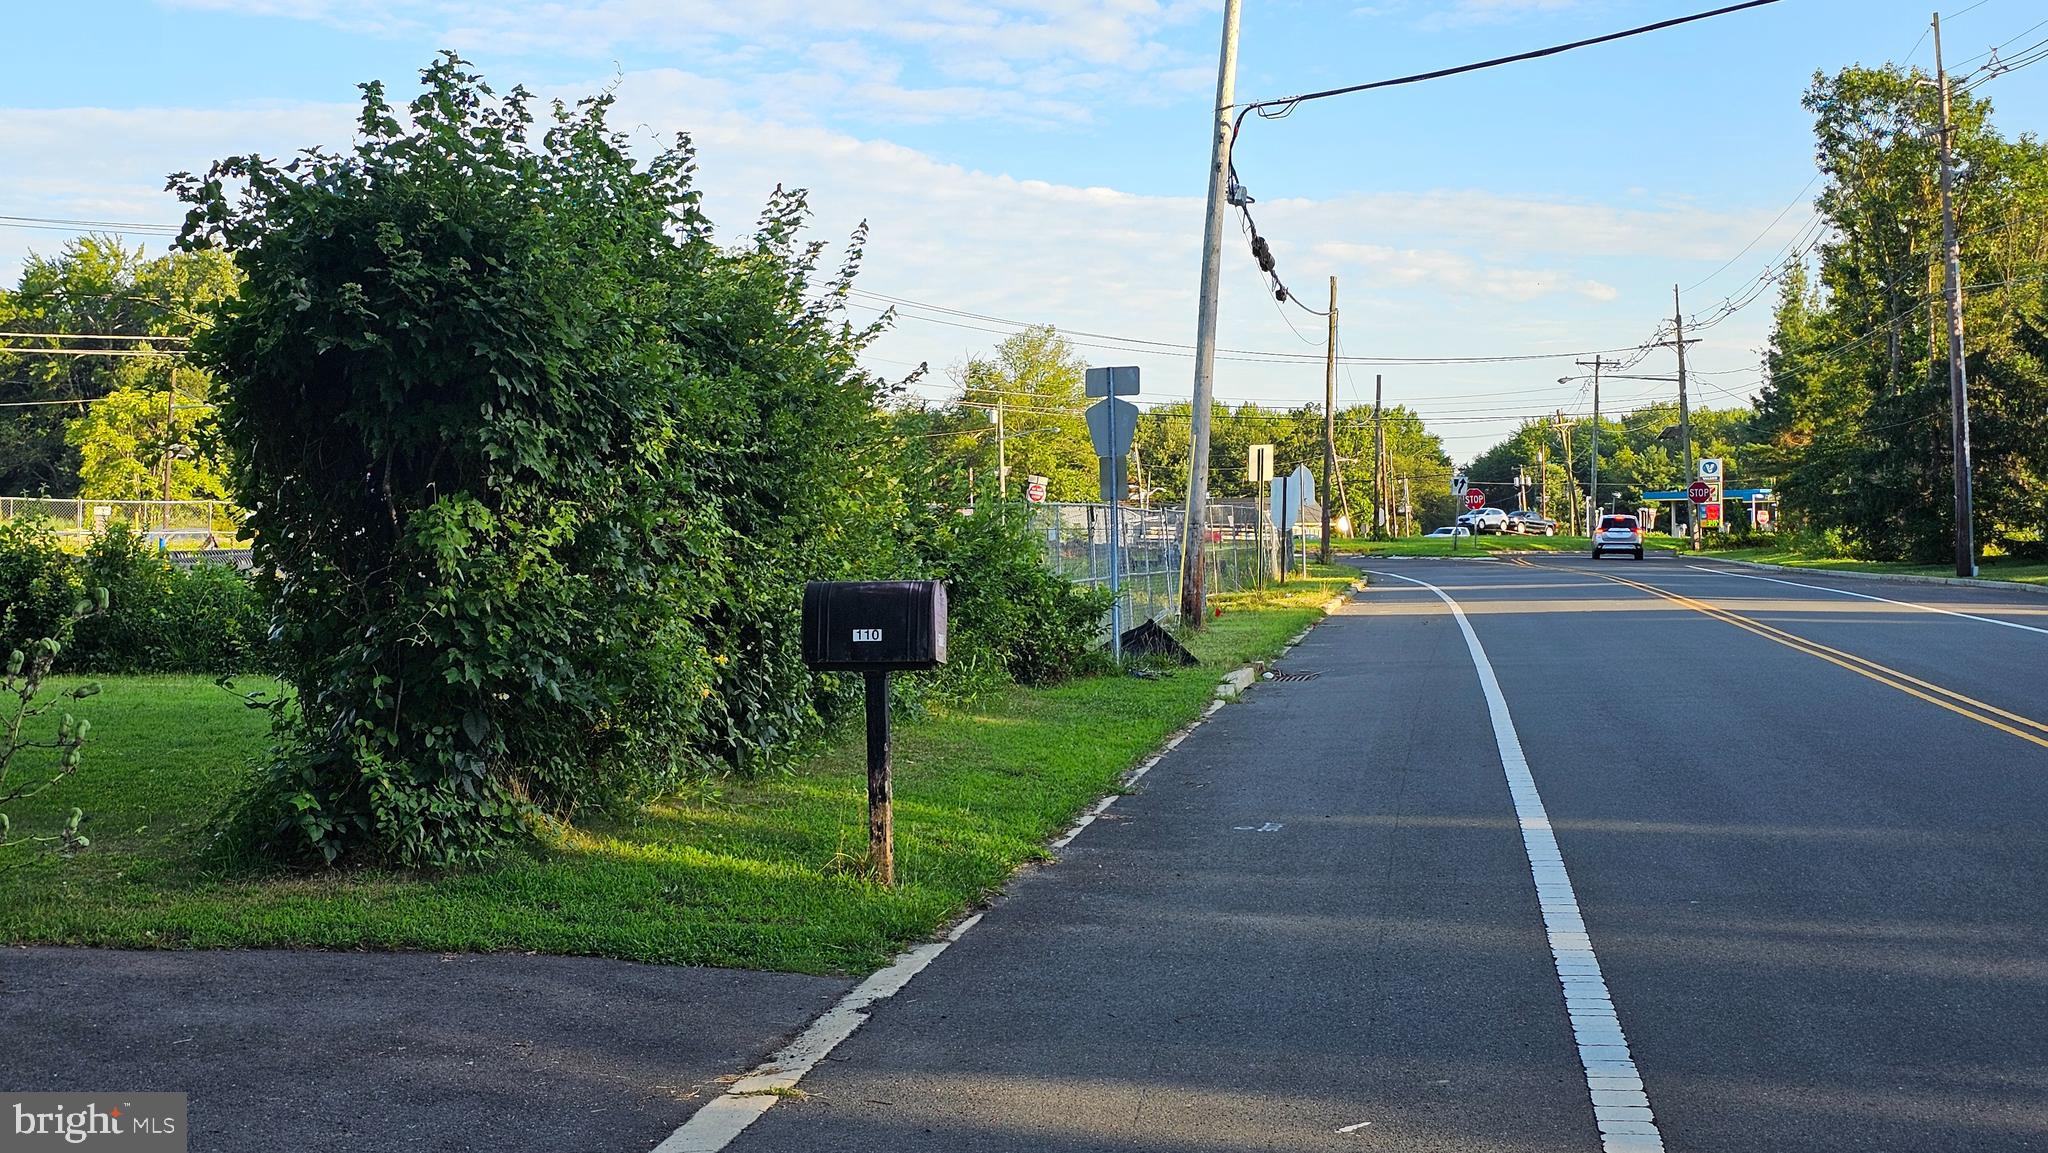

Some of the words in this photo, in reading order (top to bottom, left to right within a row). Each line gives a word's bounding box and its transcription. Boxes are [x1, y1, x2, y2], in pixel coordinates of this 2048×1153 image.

[1689, 488, 1709, 497] STOP
[1465, 495, 1484, 504] STOP
[856, 629, 880, 641] 110
